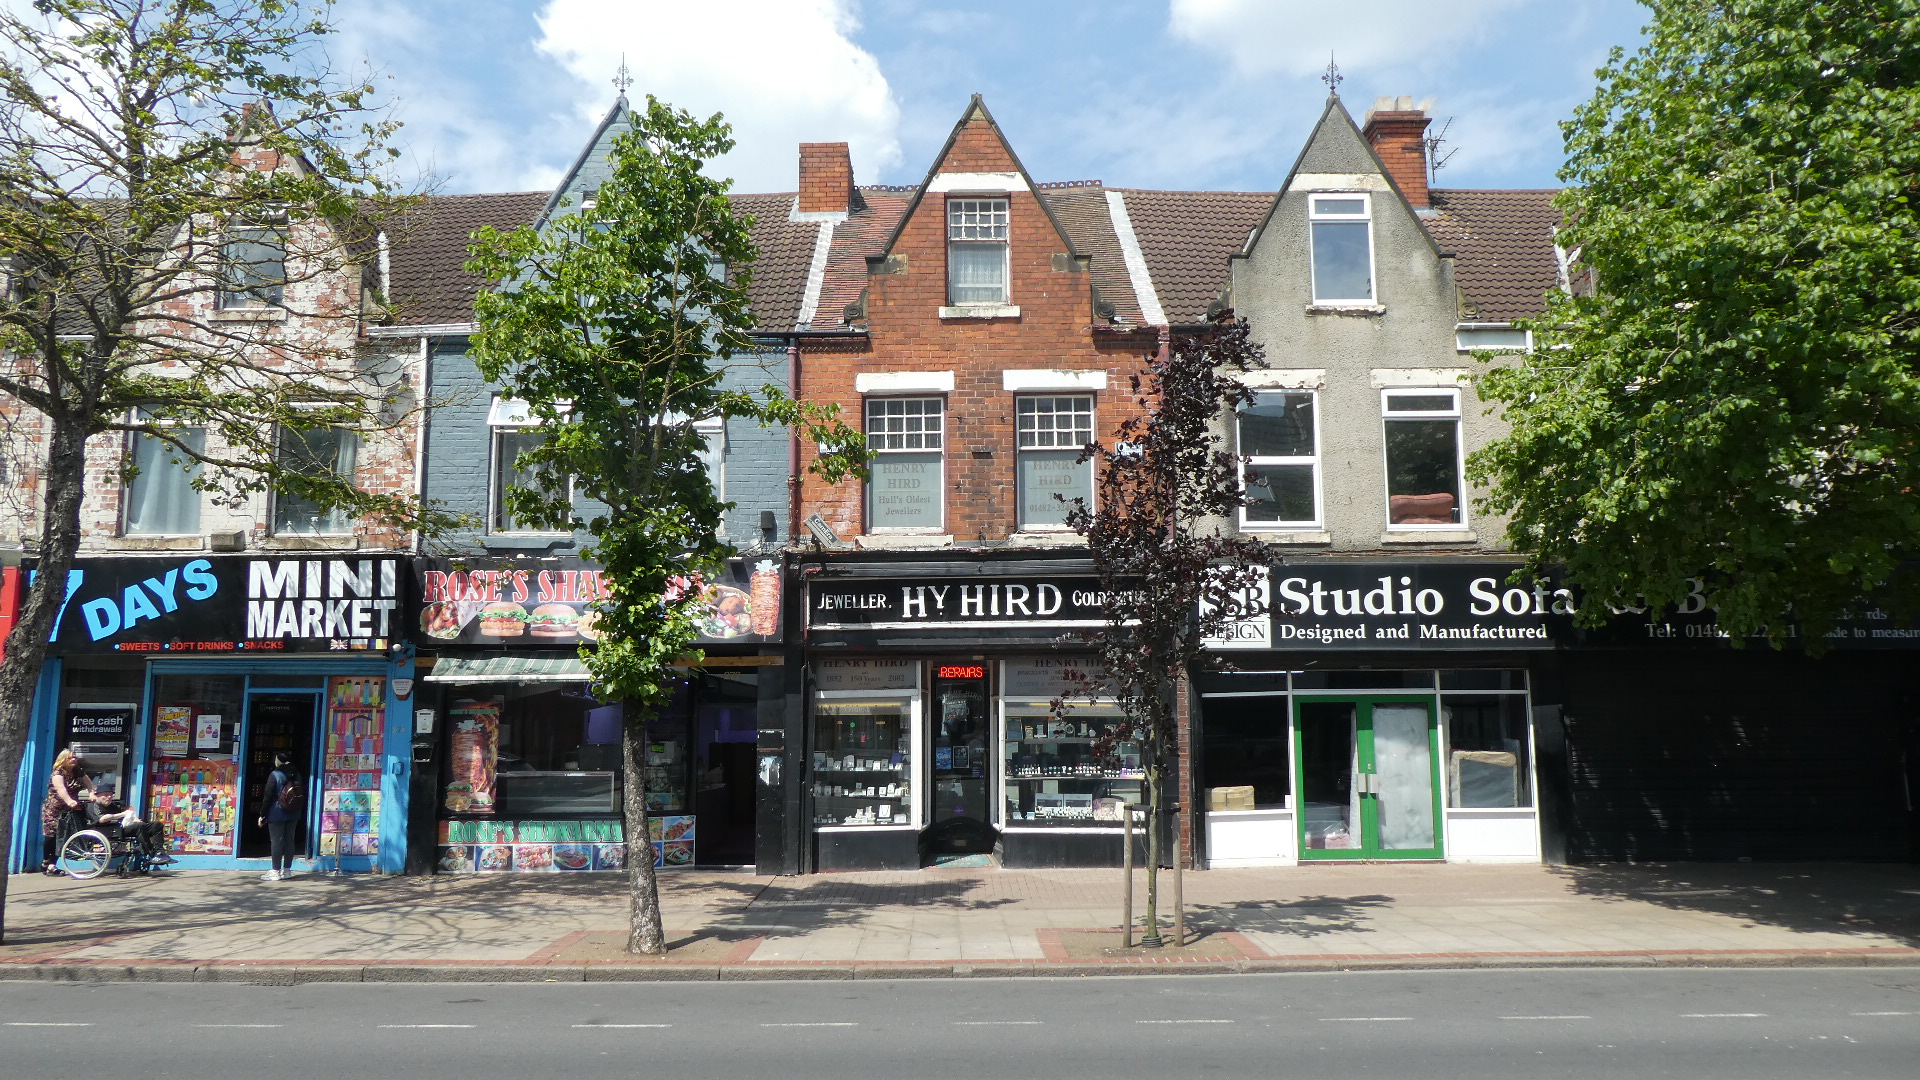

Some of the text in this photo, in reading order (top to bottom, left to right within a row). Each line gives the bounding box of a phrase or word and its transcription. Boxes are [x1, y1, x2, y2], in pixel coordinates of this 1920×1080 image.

[883, 463, 926, 473] HENRY
[888, 478, 921, 489] HIRD
[1038, 475, 1072, 485] HIRD
[878, 494, 931, 504] Hull's Oldest
[885, 507, 922, 516] Jewellers
[248, 560, 397, 599] MINI
[423, 570, 529, 603] ROSE'S
[81, 559, 218, 642] DAYS
[960, 583, 1062, 616] HIRD
[1279, 576, 1444, 616] Studio
[247, 600, 397, 639] MARKET
[1280, 623, 1548, 643] Designed and Manufactured
[1644, 622, 1676, 639] Tel:
[1854, 627, 1866, 638] to
[119, 641, 284, 651] SWEETS SOFT DRINKS SNACKS
[73, 716, 123, 725] free cash
[448, 820, 622, 843] ROSE'S SHAWARMA
